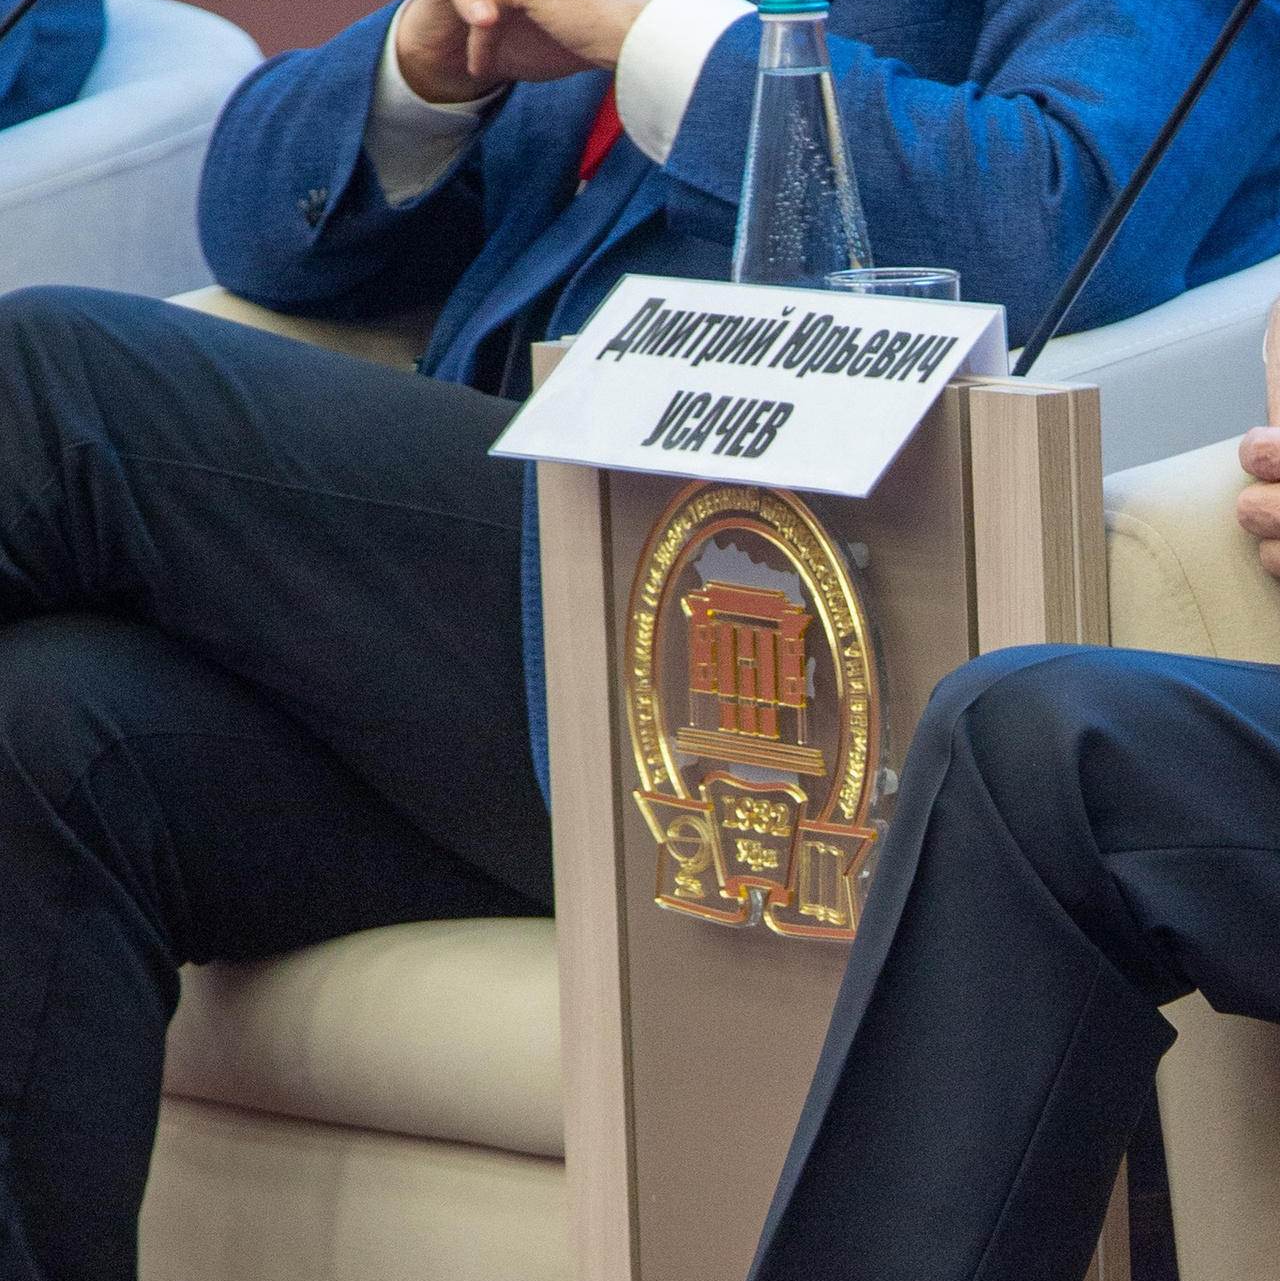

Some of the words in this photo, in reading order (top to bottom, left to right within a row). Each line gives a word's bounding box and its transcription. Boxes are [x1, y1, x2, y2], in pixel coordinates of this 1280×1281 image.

[597, 298, 795, 367] Дмитрий
[768, 312, 959, 383] Юрьевич
[641, 390, 795, 459] УСАЧЕВ
[721, 796, 793, 837] 1932
